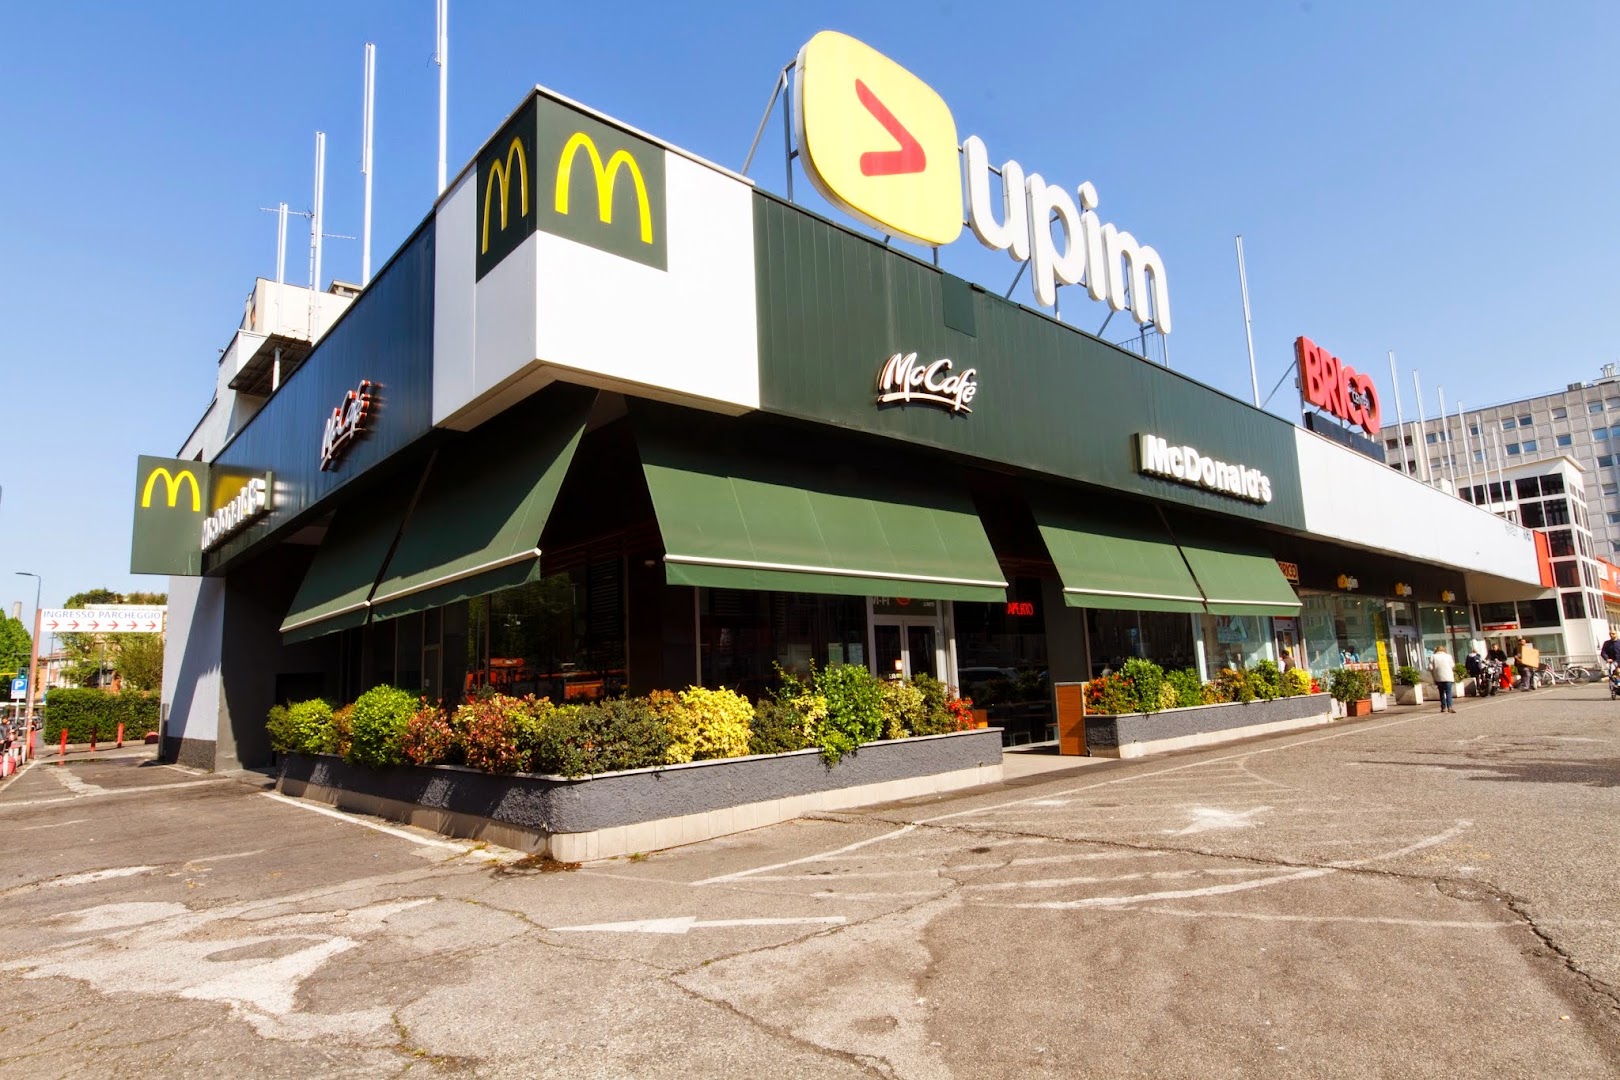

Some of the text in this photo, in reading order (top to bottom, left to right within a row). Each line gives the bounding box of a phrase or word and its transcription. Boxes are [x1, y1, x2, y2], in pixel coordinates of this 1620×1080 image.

[963, 135, 1172, 335] upim
[878, 352, 978, 412] McCafé
[1297, 335, 1381, 435] BRICO
[1142, 434, 1273, 504] McDonald's
[43, 610, 161, 619] INGRESSO PARCHEGGIO
